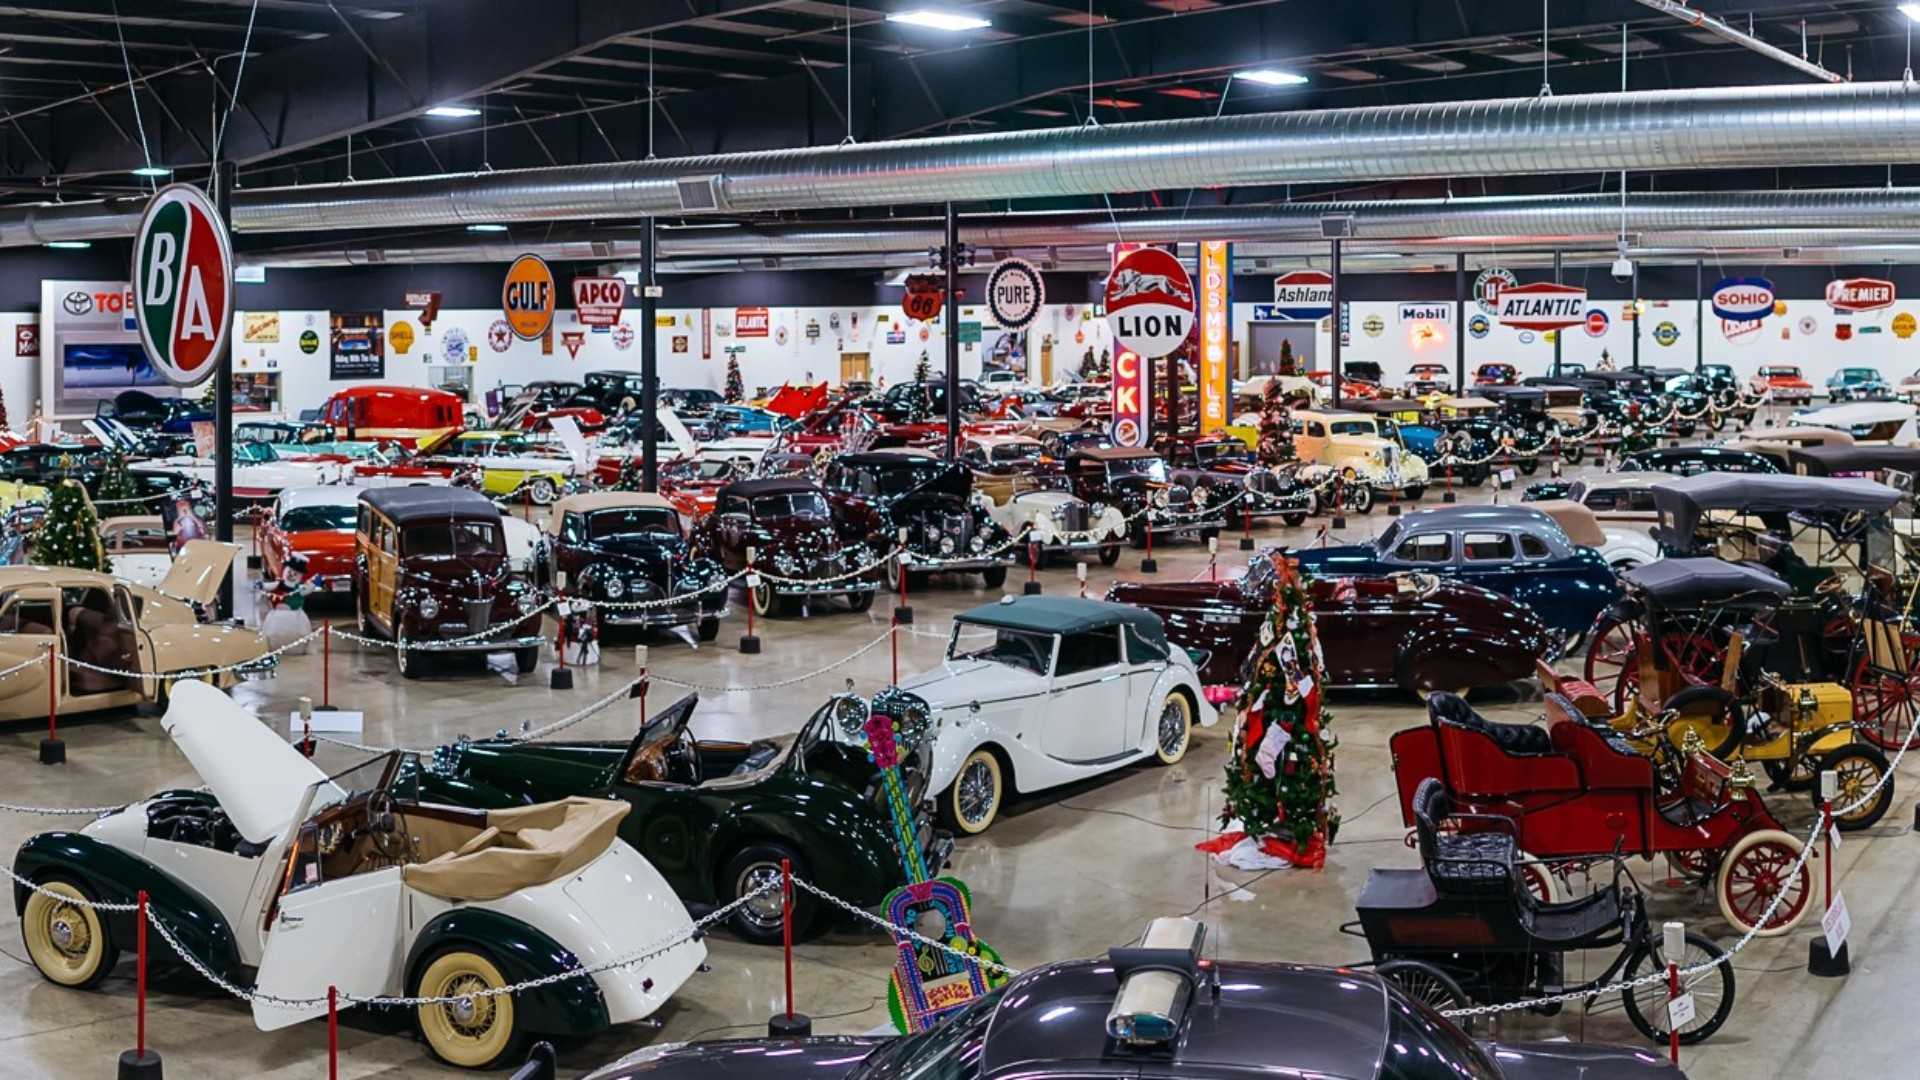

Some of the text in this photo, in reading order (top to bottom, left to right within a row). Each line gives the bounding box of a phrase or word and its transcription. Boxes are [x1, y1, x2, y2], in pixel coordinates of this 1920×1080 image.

[507, 281, 548, 311] GULF
[580, 283, 621, 304] APCO
[998, 285, 1031, 304] PURE
[1717, 293, 1769, 305] SOHIO
[911, 295, 933, 315] 66
[1403, 308, 1446, 319] Mobil
[1503, 299, 1582, 316] ATLANTIC
[1118, 315, 1182, 337] LION
